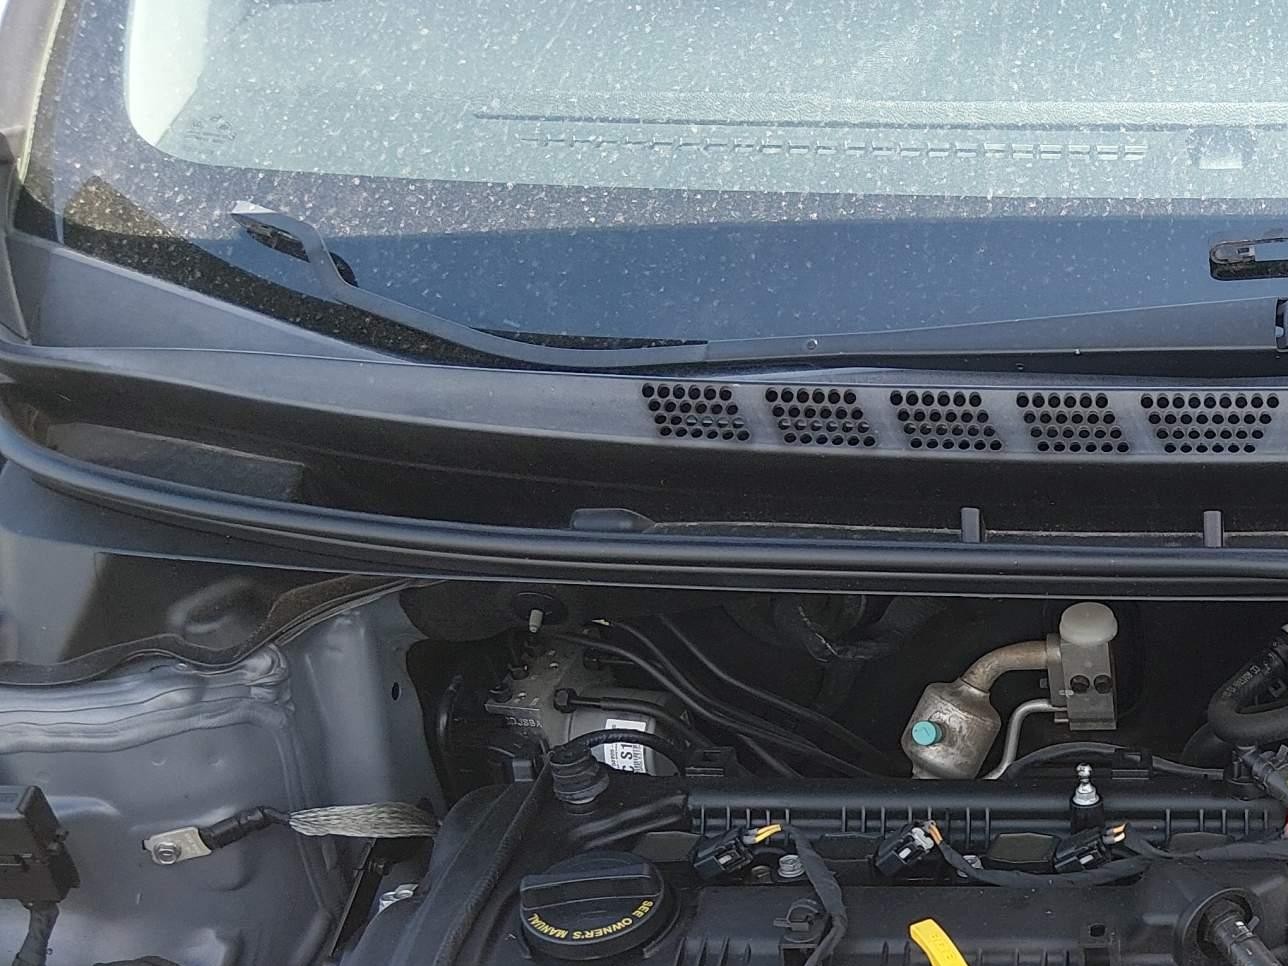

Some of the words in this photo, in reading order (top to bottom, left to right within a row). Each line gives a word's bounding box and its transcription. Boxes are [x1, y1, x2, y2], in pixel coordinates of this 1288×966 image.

[631, 899, 654, 919] SEE
[527, 912, 569, 939] MANUAL
[571, 916, 633, 940] OWNER'S
